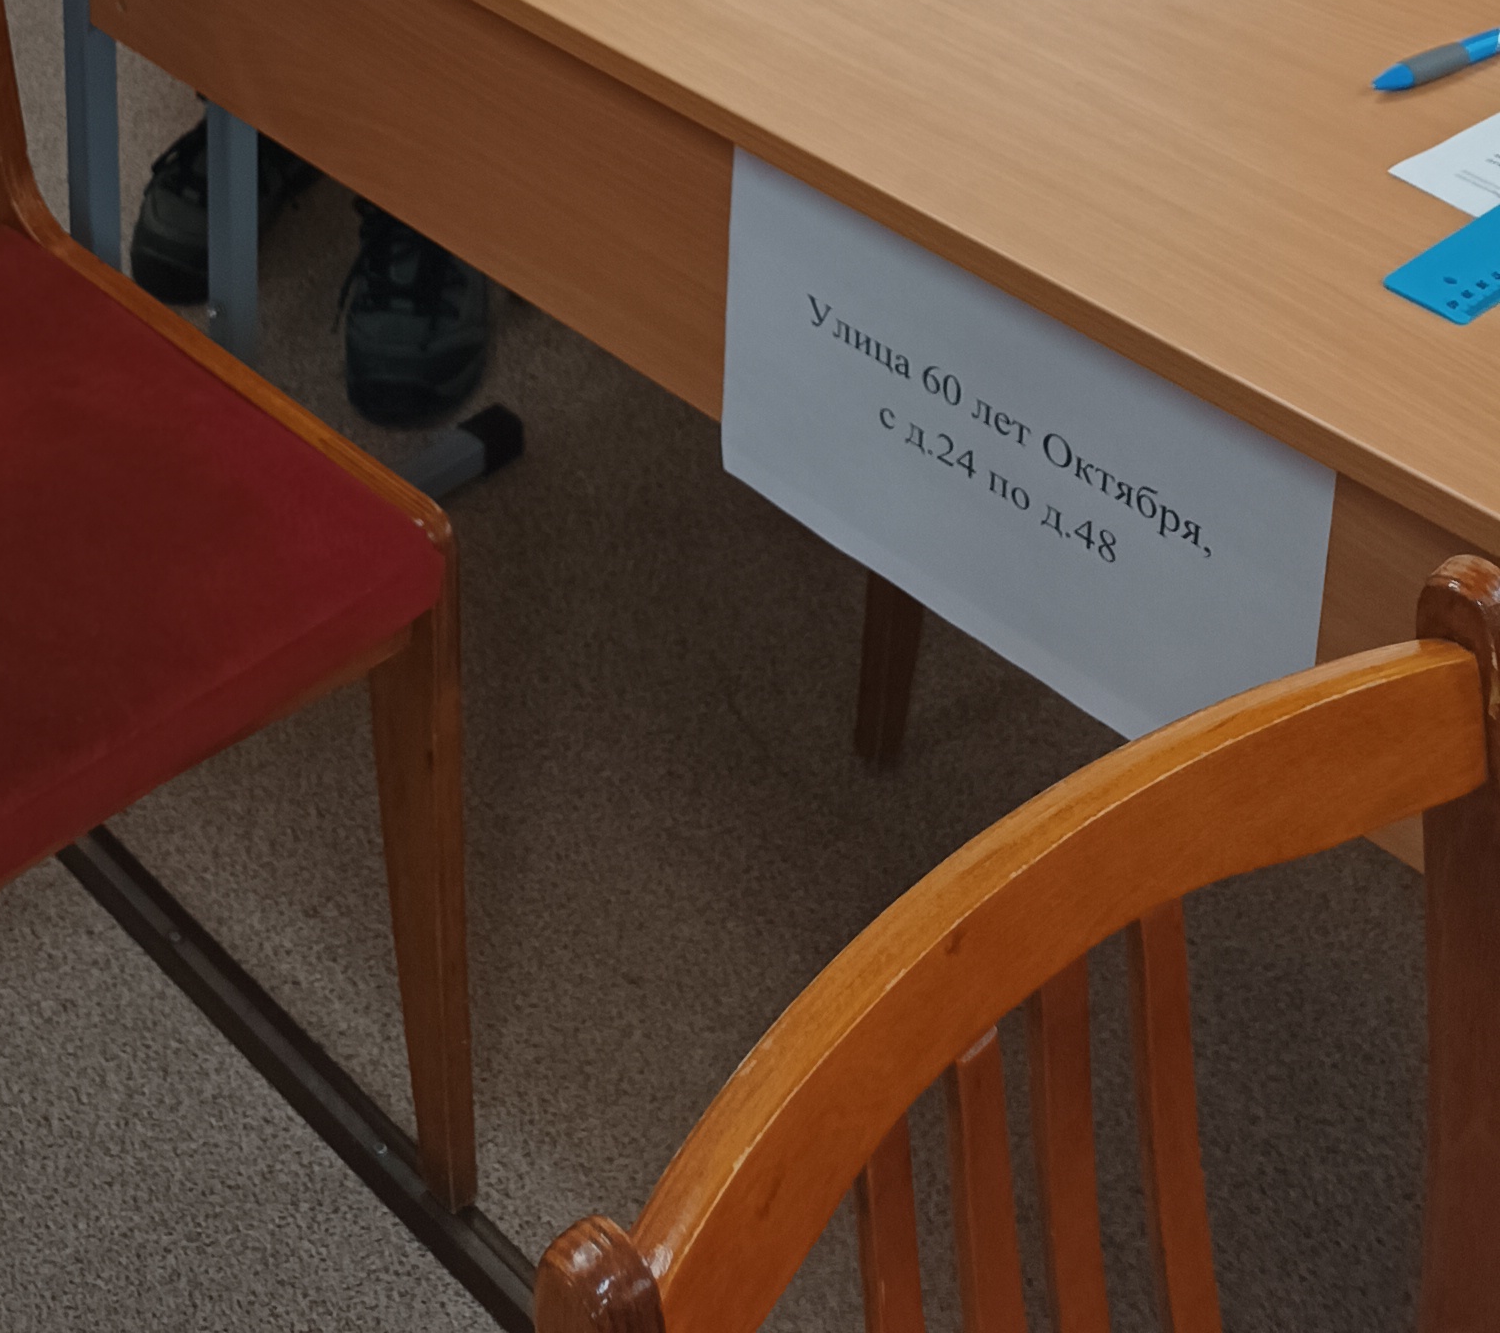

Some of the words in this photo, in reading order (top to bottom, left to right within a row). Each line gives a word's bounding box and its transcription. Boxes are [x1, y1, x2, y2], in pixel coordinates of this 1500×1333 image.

[807, 293, 911, 380] Улица
[922, 365, 962, 406] 60
[971, 398, 1032, 447] лет
[1043, 433, 1212, 559] Октября,
[879, 407, 897, 430] с
[905, 422, 977, 479] д.24
[989, 470, 1030, 507] по
[1041, 504, 1117, 564] д.48
